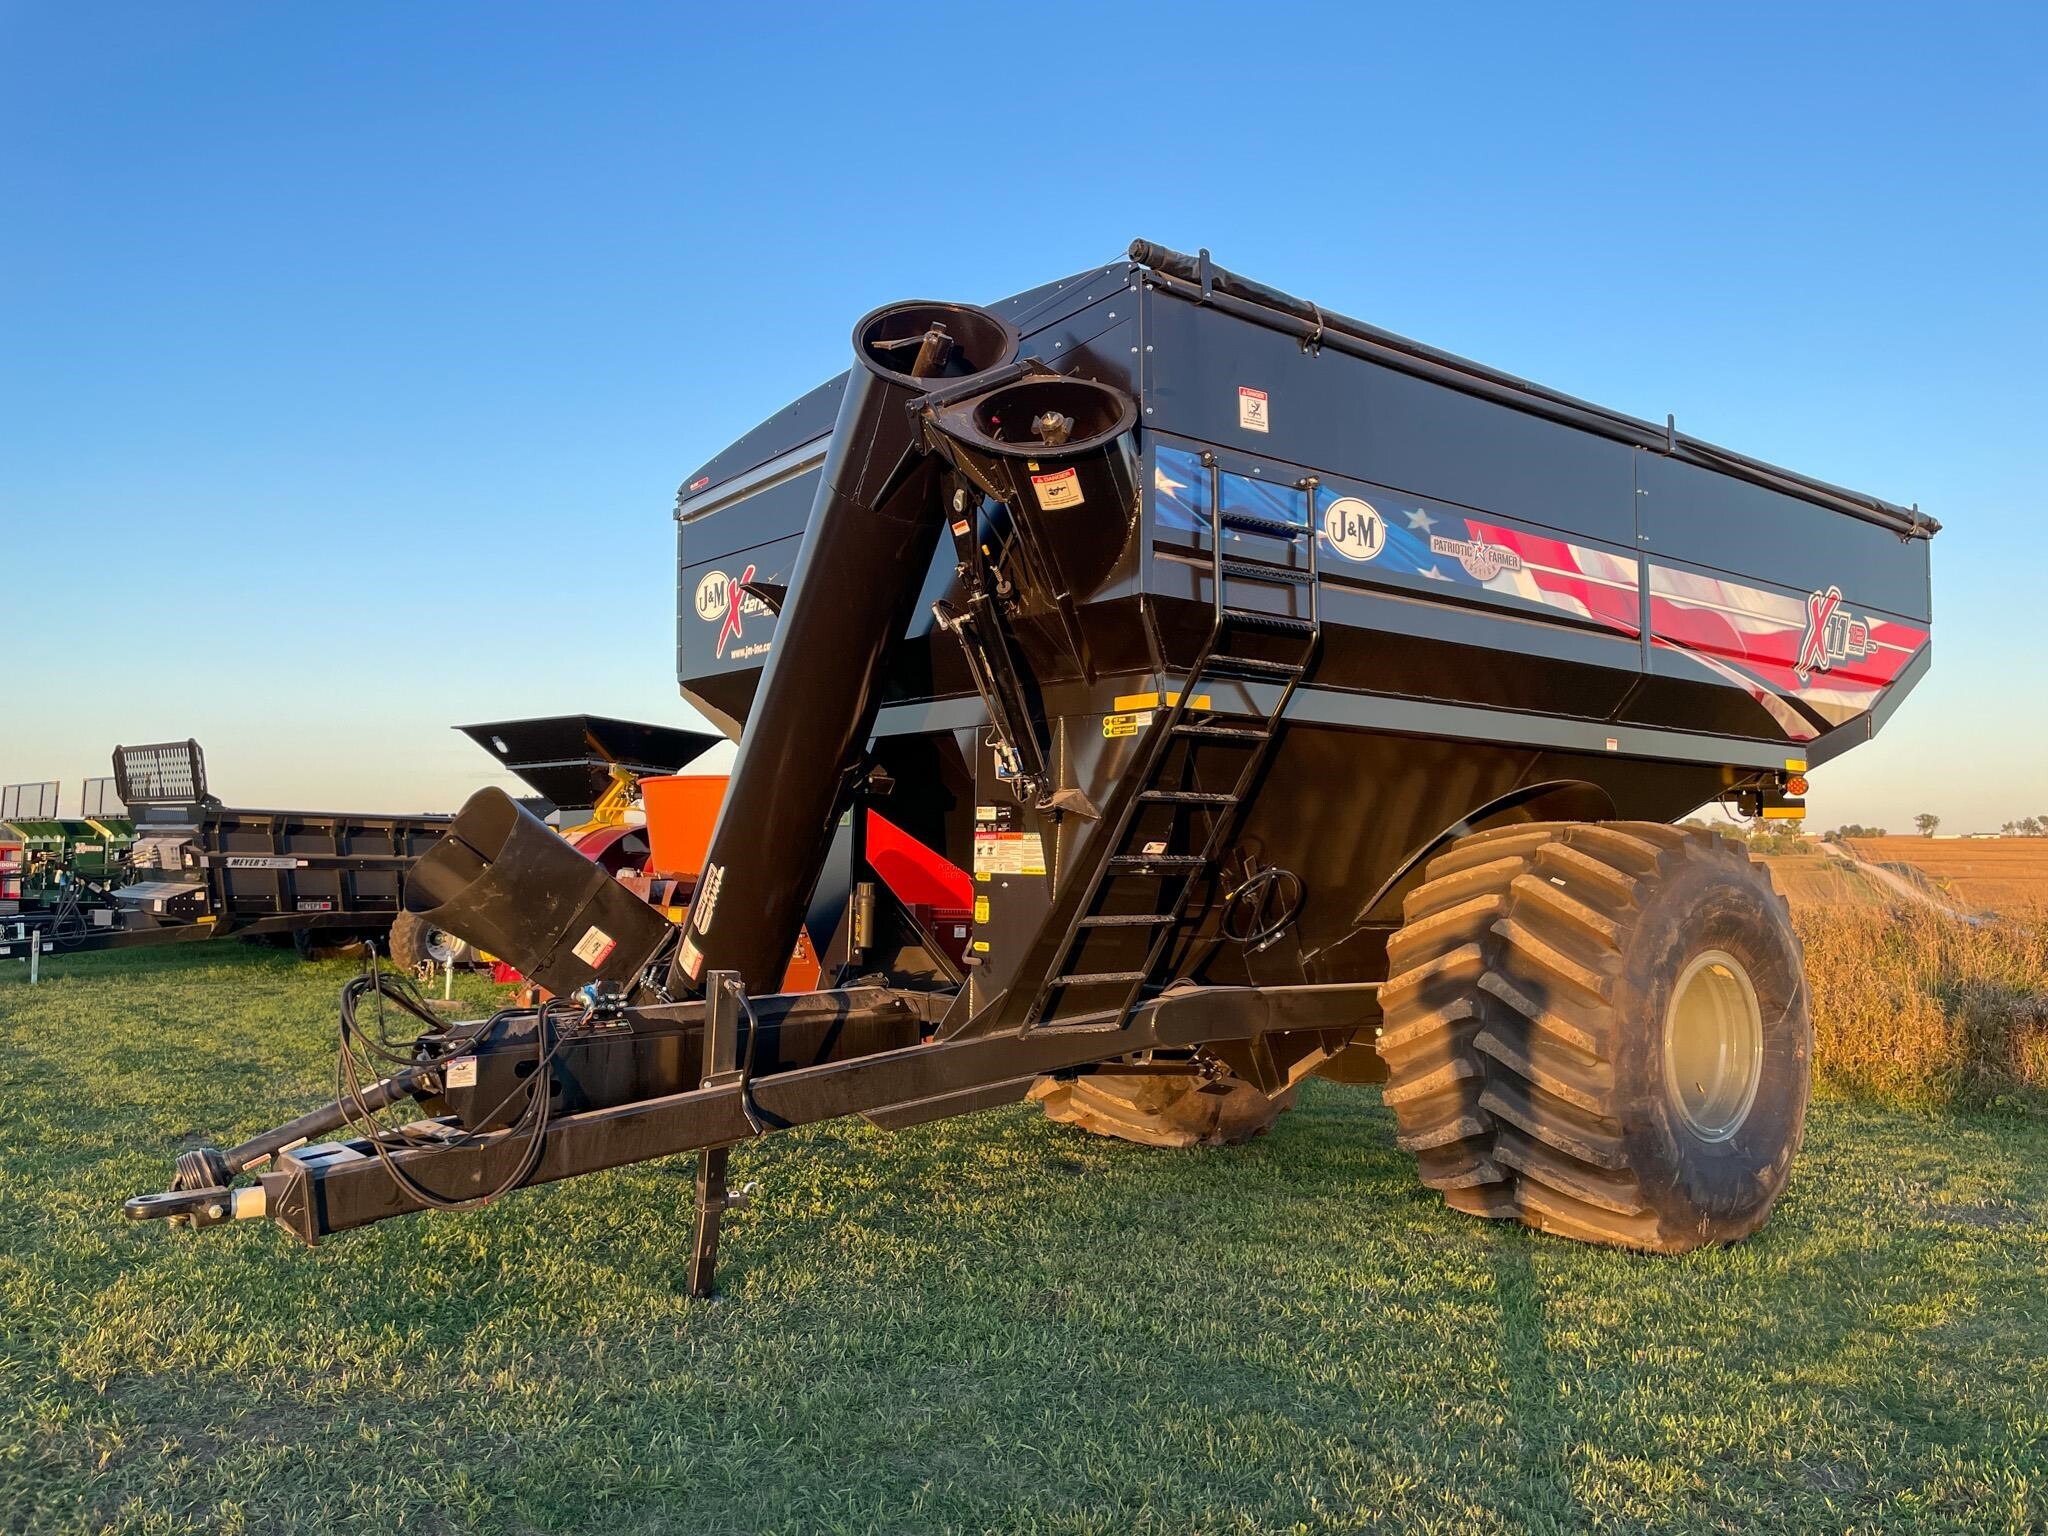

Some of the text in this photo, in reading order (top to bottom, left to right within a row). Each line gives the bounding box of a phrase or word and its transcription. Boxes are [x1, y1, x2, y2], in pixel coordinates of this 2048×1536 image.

[1330, 510, 1376, 549] J&M
[1433, 538, 1519, 568] PATRIOTIC FARMER
[699, 580, 725, 612] J&M
[731, 642, 771, 659] www.jm-inc.co
[230, 858, 269, 867] MEYER'S
